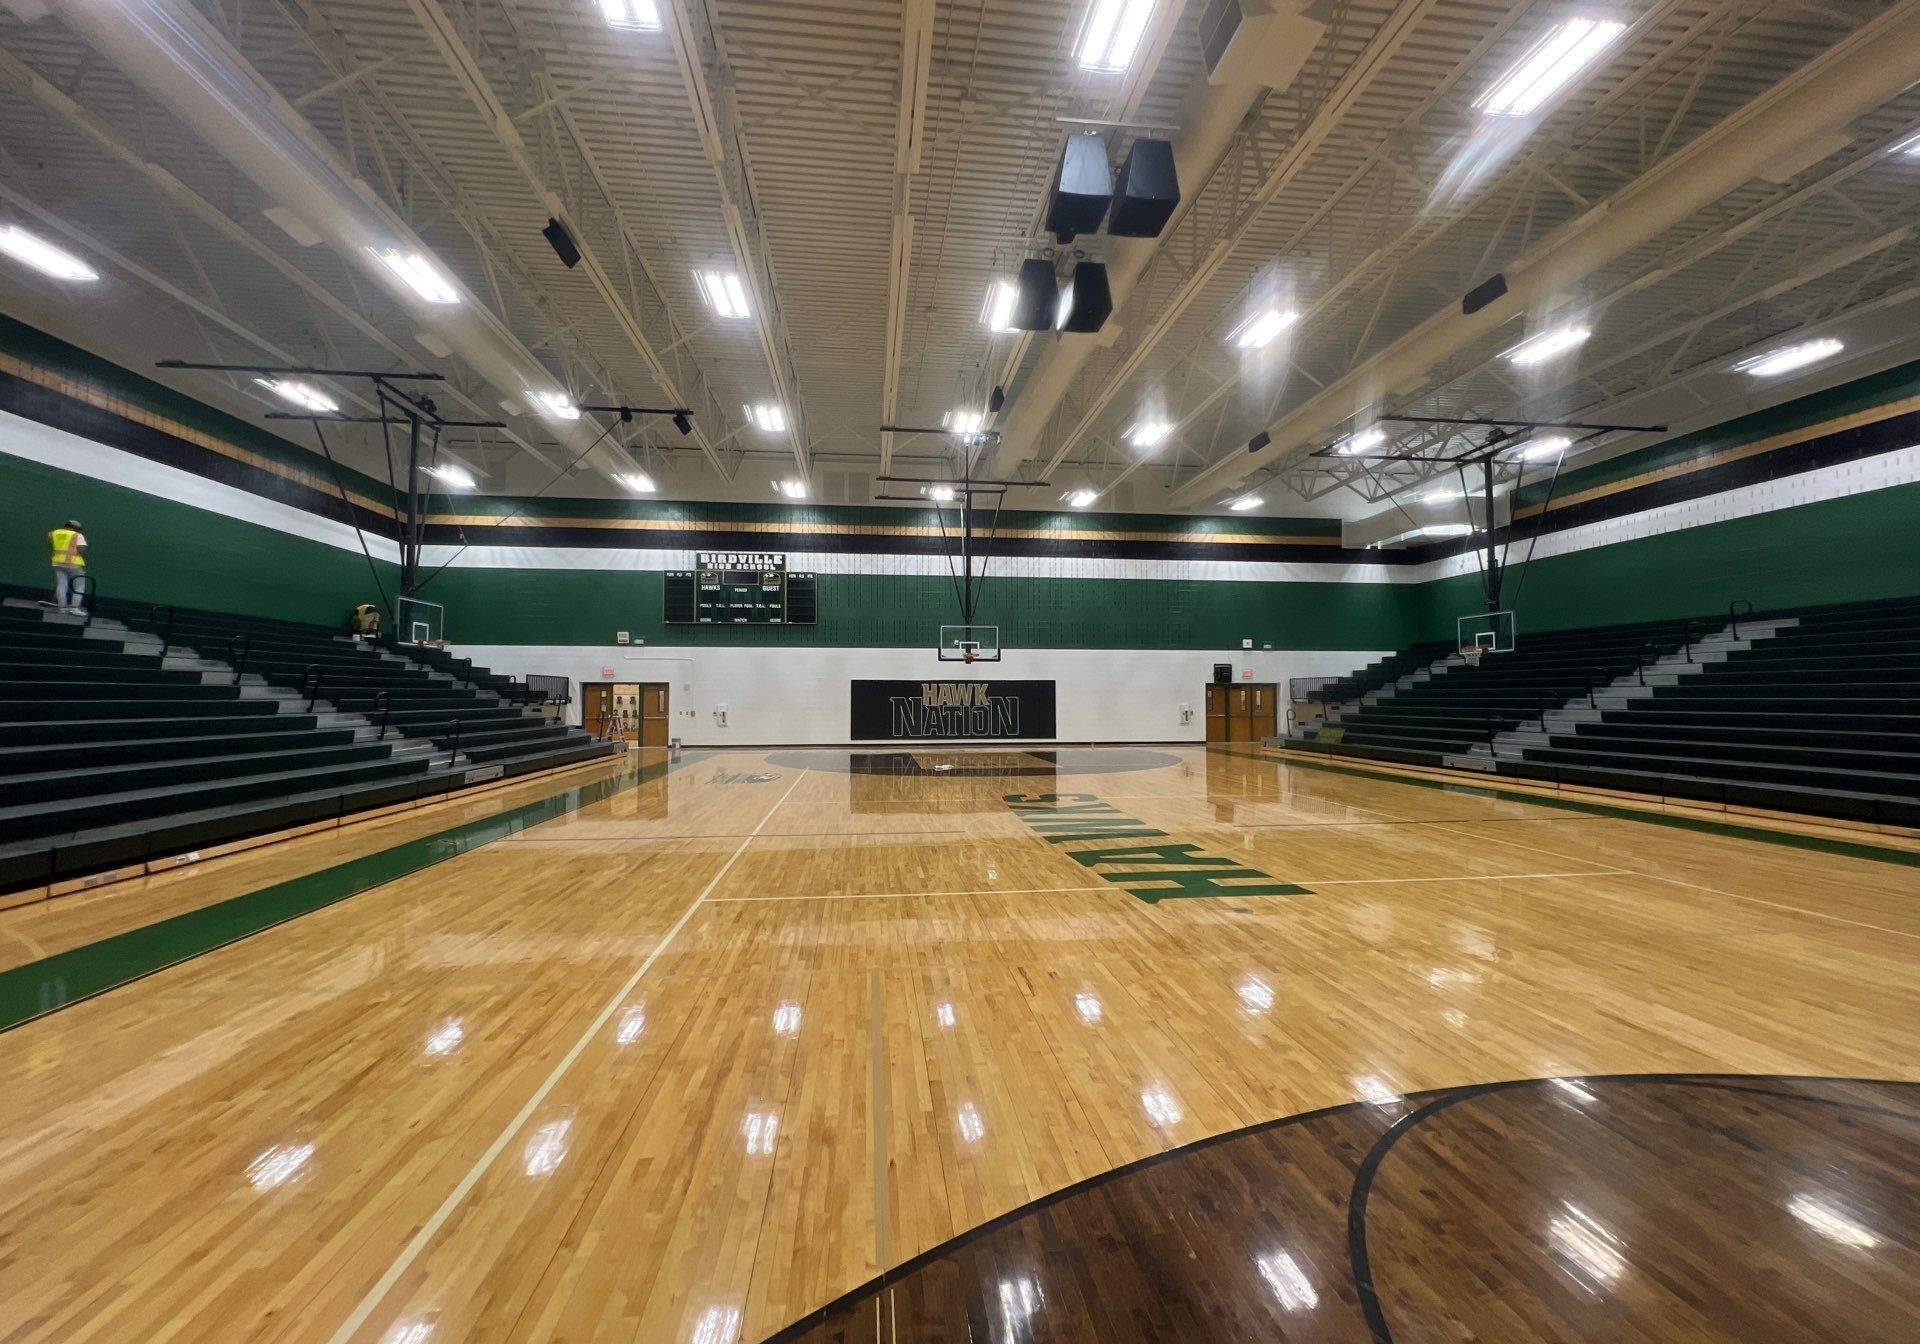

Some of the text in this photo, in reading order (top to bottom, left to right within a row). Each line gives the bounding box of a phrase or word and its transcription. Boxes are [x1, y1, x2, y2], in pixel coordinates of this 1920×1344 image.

[700, 554, 783, 565] BIRDVILLE
[922, 683, 990, 706] HAWK
[890, 697, 1020, 736] NATION
[1002, 794, 1318, 905] HAWKS
